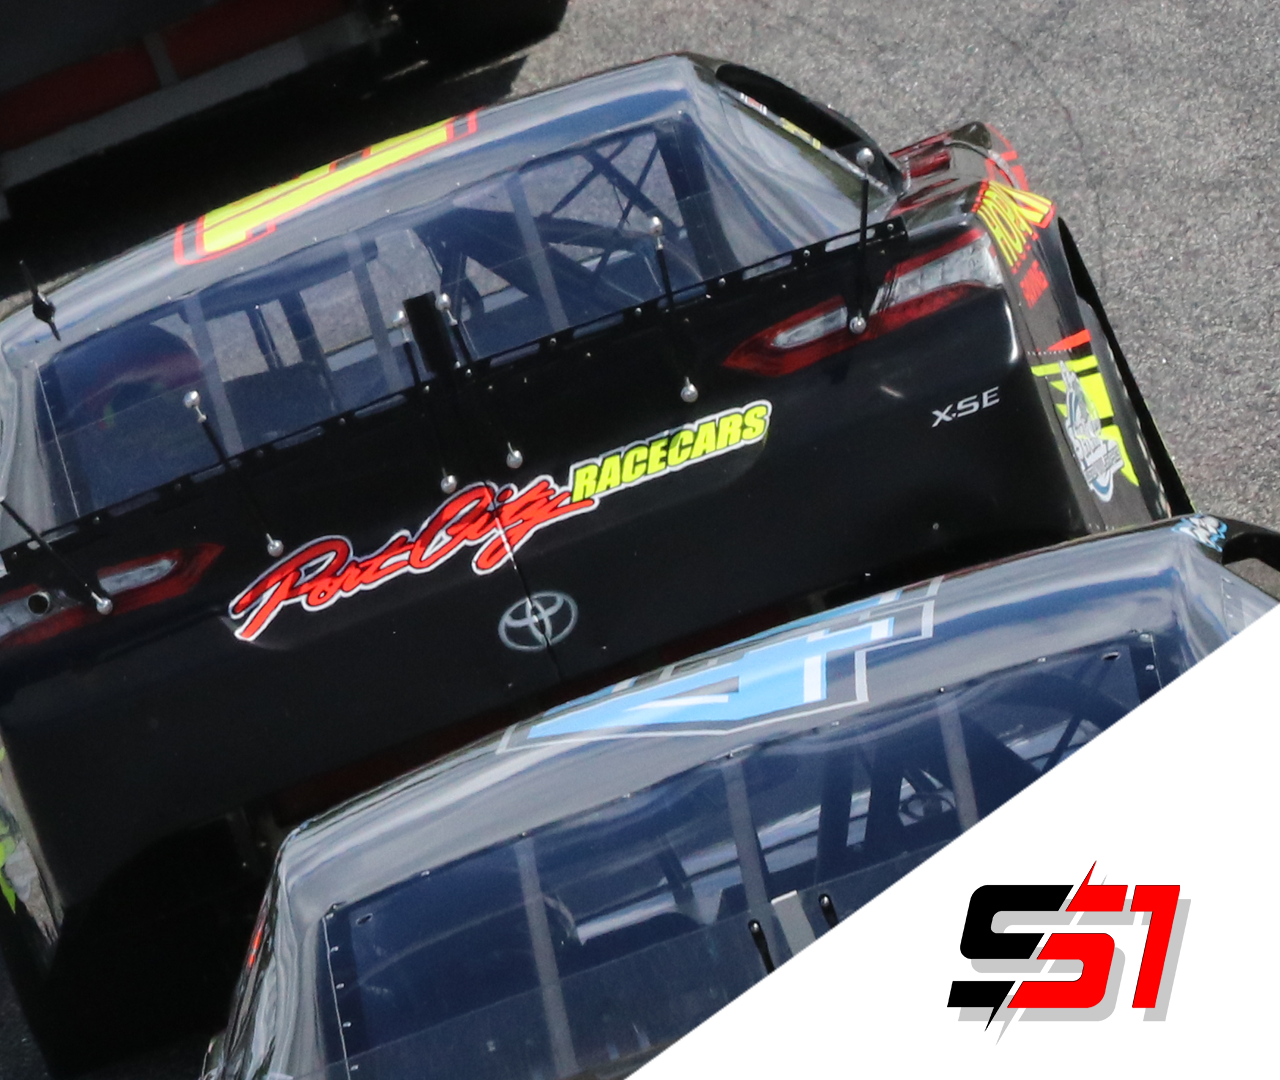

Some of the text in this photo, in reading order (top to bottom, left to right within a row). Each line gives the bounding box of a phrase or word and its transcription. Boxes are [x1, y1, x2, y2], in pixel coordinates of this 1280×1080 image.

[930, 385, 1001, 428] XSE
[229, 398, 773, 642] Port City RACECARS
